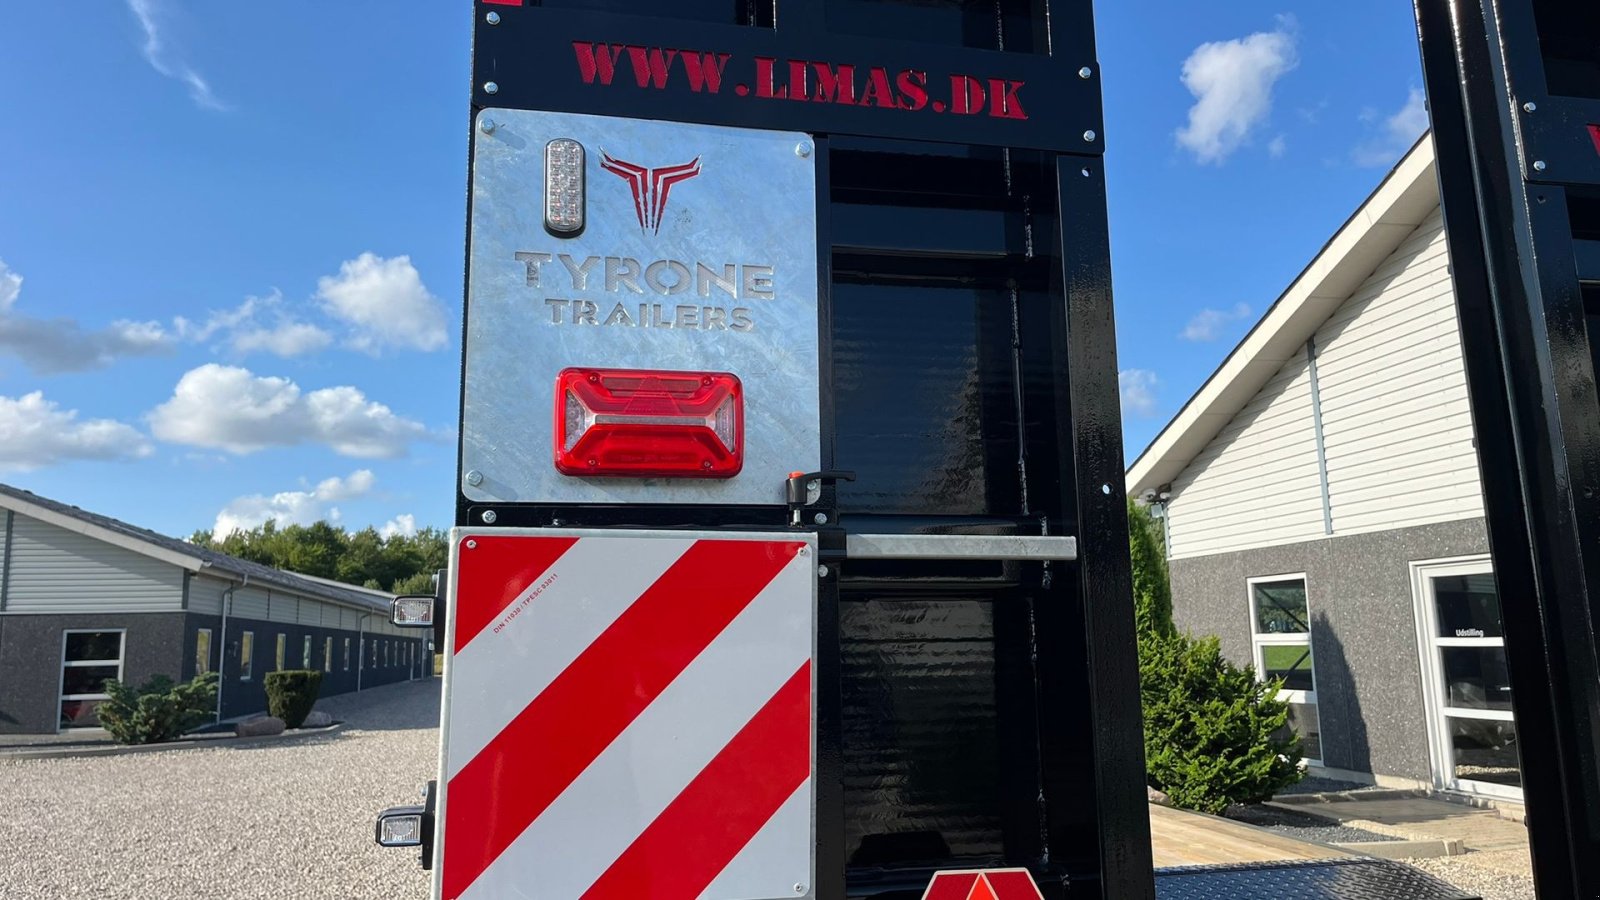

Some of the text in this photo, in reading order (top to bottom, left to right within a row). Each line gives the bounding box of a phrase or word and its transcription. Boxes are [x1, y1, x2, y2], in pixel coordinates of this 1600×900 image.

[571, 40, 1029, 121] WWW.LIMAS.DK
[514, 251, 776, 300] TYRONE
[544, 298, 755, 332] TRAILERS
[493, 622, 506, 634] DIN
[1455, 628, 1484, 638] Udstilling
